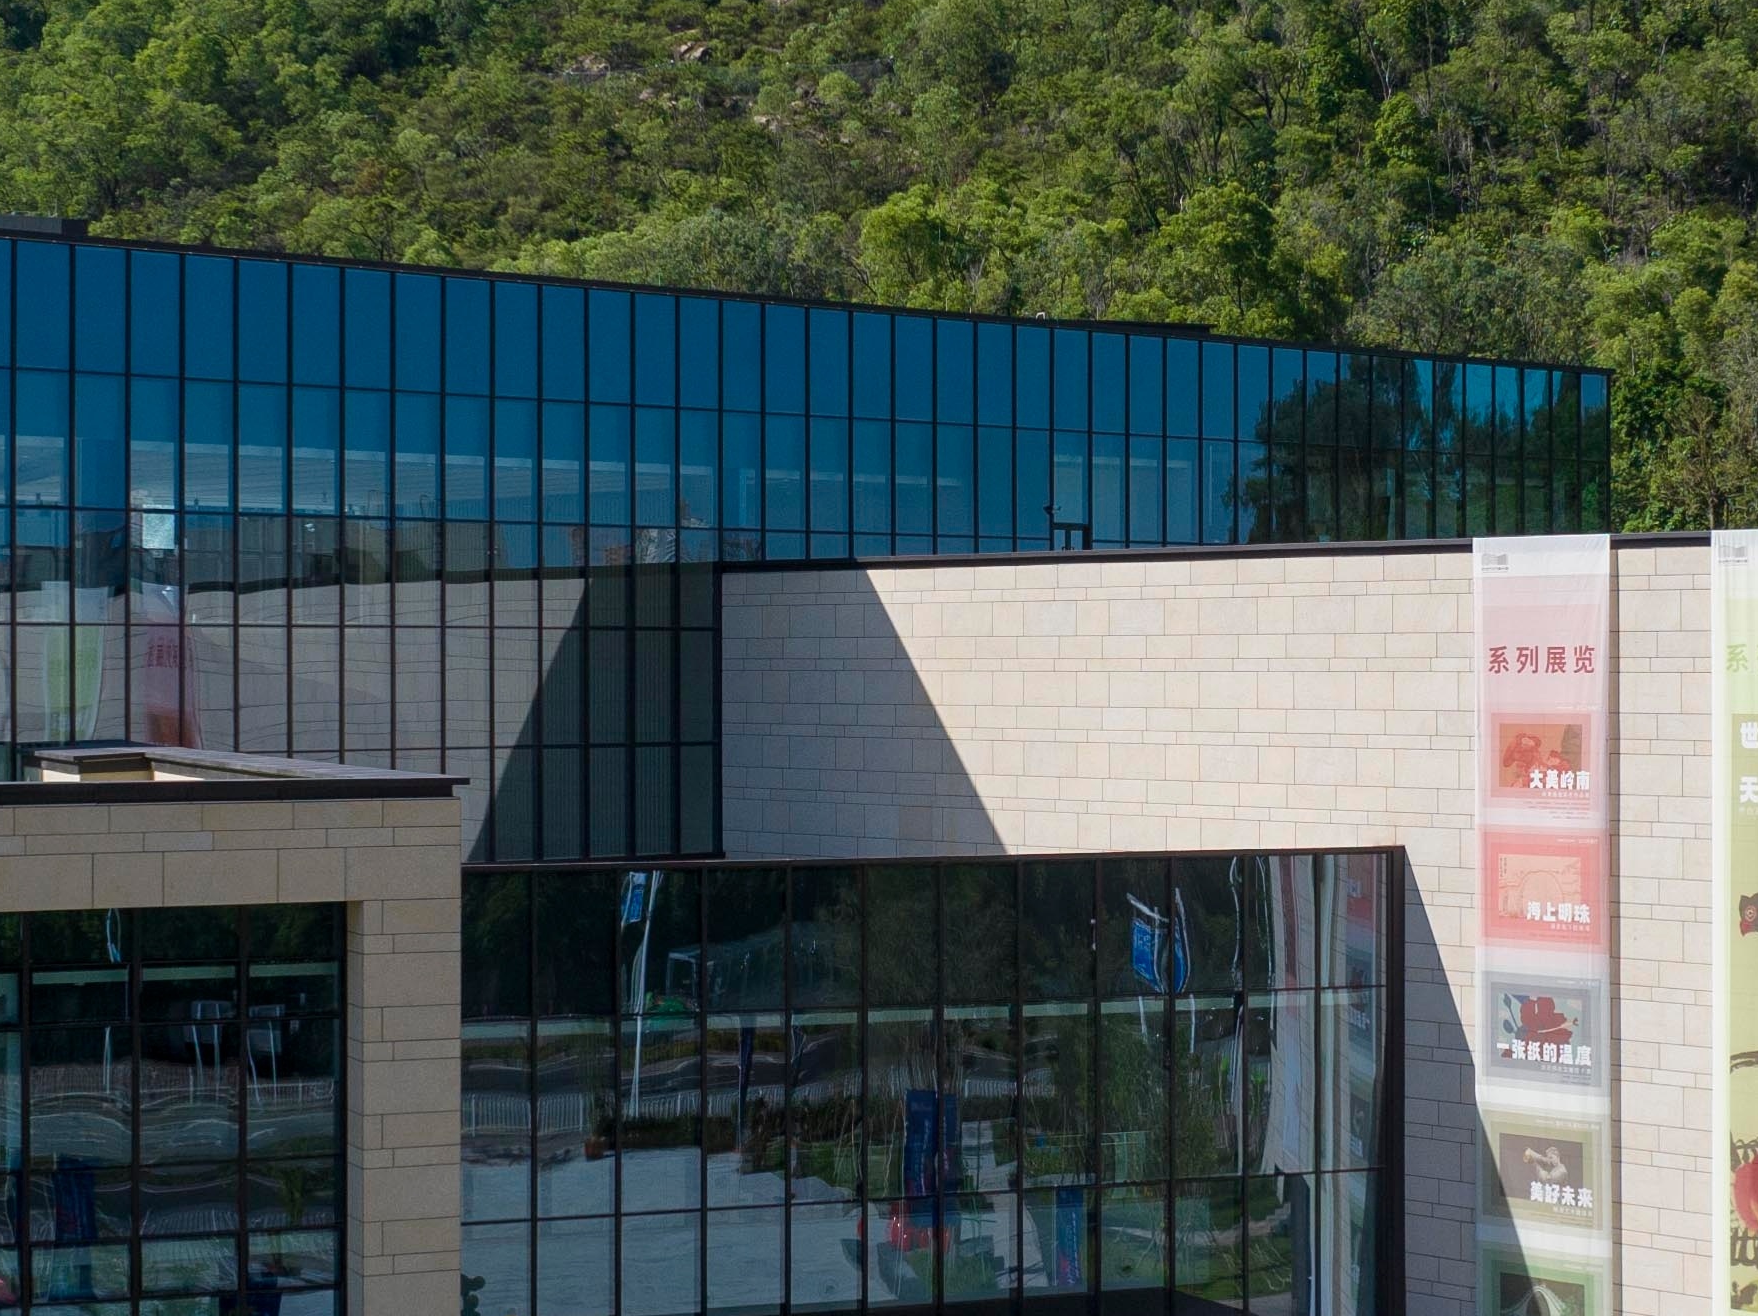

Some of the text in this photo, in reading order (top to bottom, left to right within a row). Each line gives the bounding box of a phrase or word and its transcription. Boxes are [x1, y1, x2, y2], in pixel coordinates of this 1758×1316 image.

[1488, 645, 1596, 674] 系列展览
[1530, 768, 1591, 789] 大美岭南
[1526, 901, 1591, 924] 海上明珠
[1496, 1039, 1592, 1066] 一张纸的温度
[1530, 1181, 1593, 1208] 美好未来
